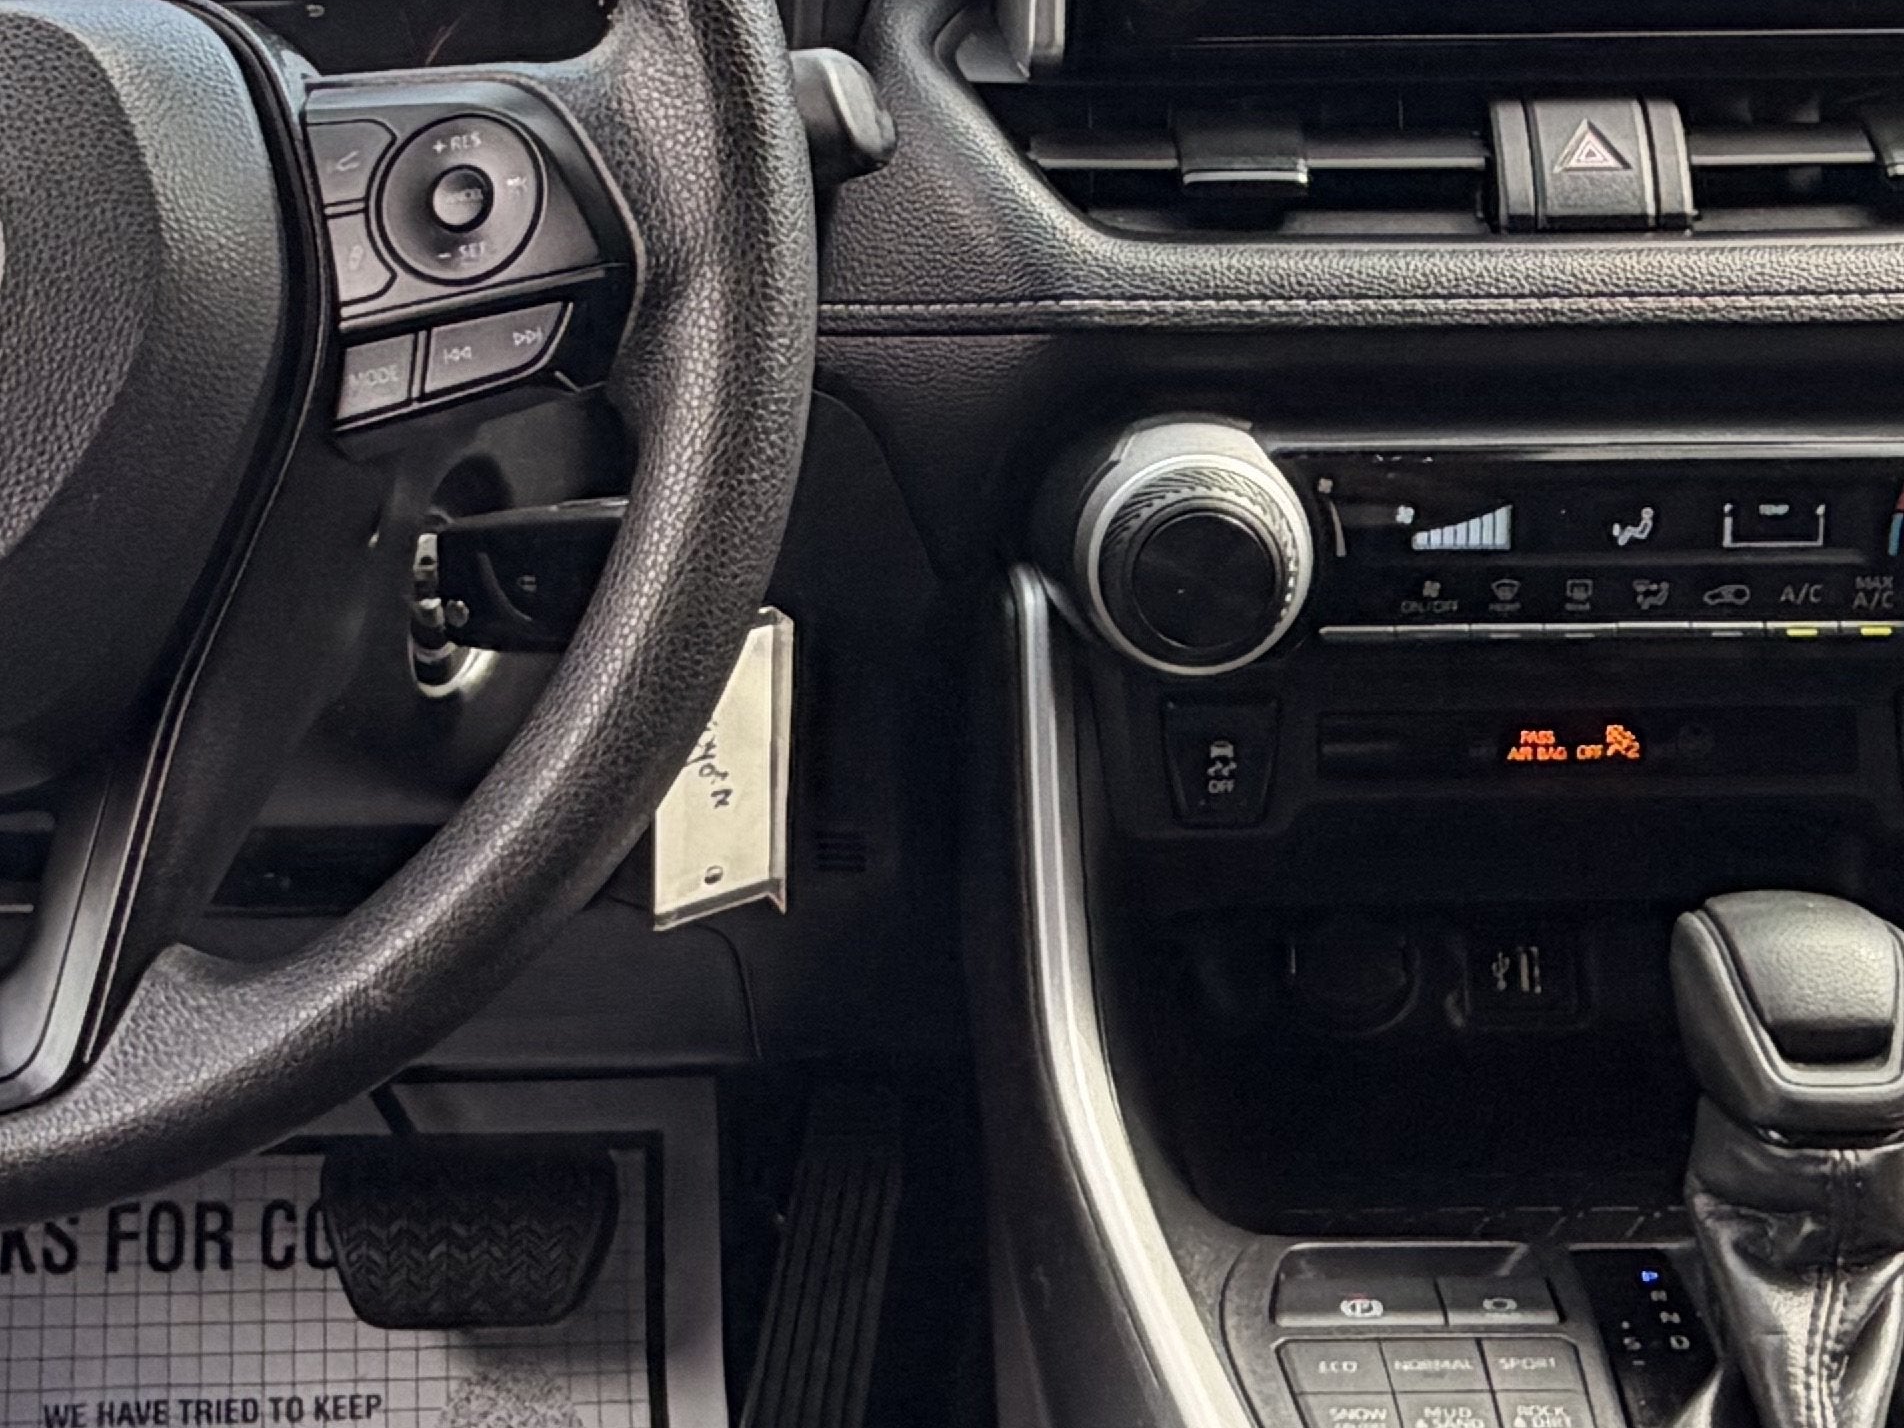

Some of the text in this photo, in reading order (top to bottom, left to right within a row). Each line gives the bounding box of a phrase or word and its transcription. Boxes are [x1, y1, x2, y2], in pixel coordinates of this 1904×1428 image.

[1780, 583, 1823, 604] A/C
[1852, 591, 1895, 611] A/C
[1520, 730, 1556, 745] PASS
[1506, 746, 1533, 761] AIR
[1536, 746, 1568, 761] BAG
[1576, 745, 1604, 760] OFF
[1208, 779, 1234, 794] OFF
[104, 1199, 235, 1273] FOR
[1318, 1360, 1358, 1374] ECO
[1395, 1357, 1474, 1371] NORMAL
[1498, 1356, 1556, 1370] SPORT
[97, 1399, 170, 1428] HAVE
[178, 1397, 259, 1426] TRIED
[268, 1396, 304, 1422] TO
[313, 1394, 382, 1421] KEEP
[1329, 1407, 1388, 1422] SNOW
[1423, 1406, 1472, 1419] MUD
[1531, 1415, 1572, 1428] DIRT
